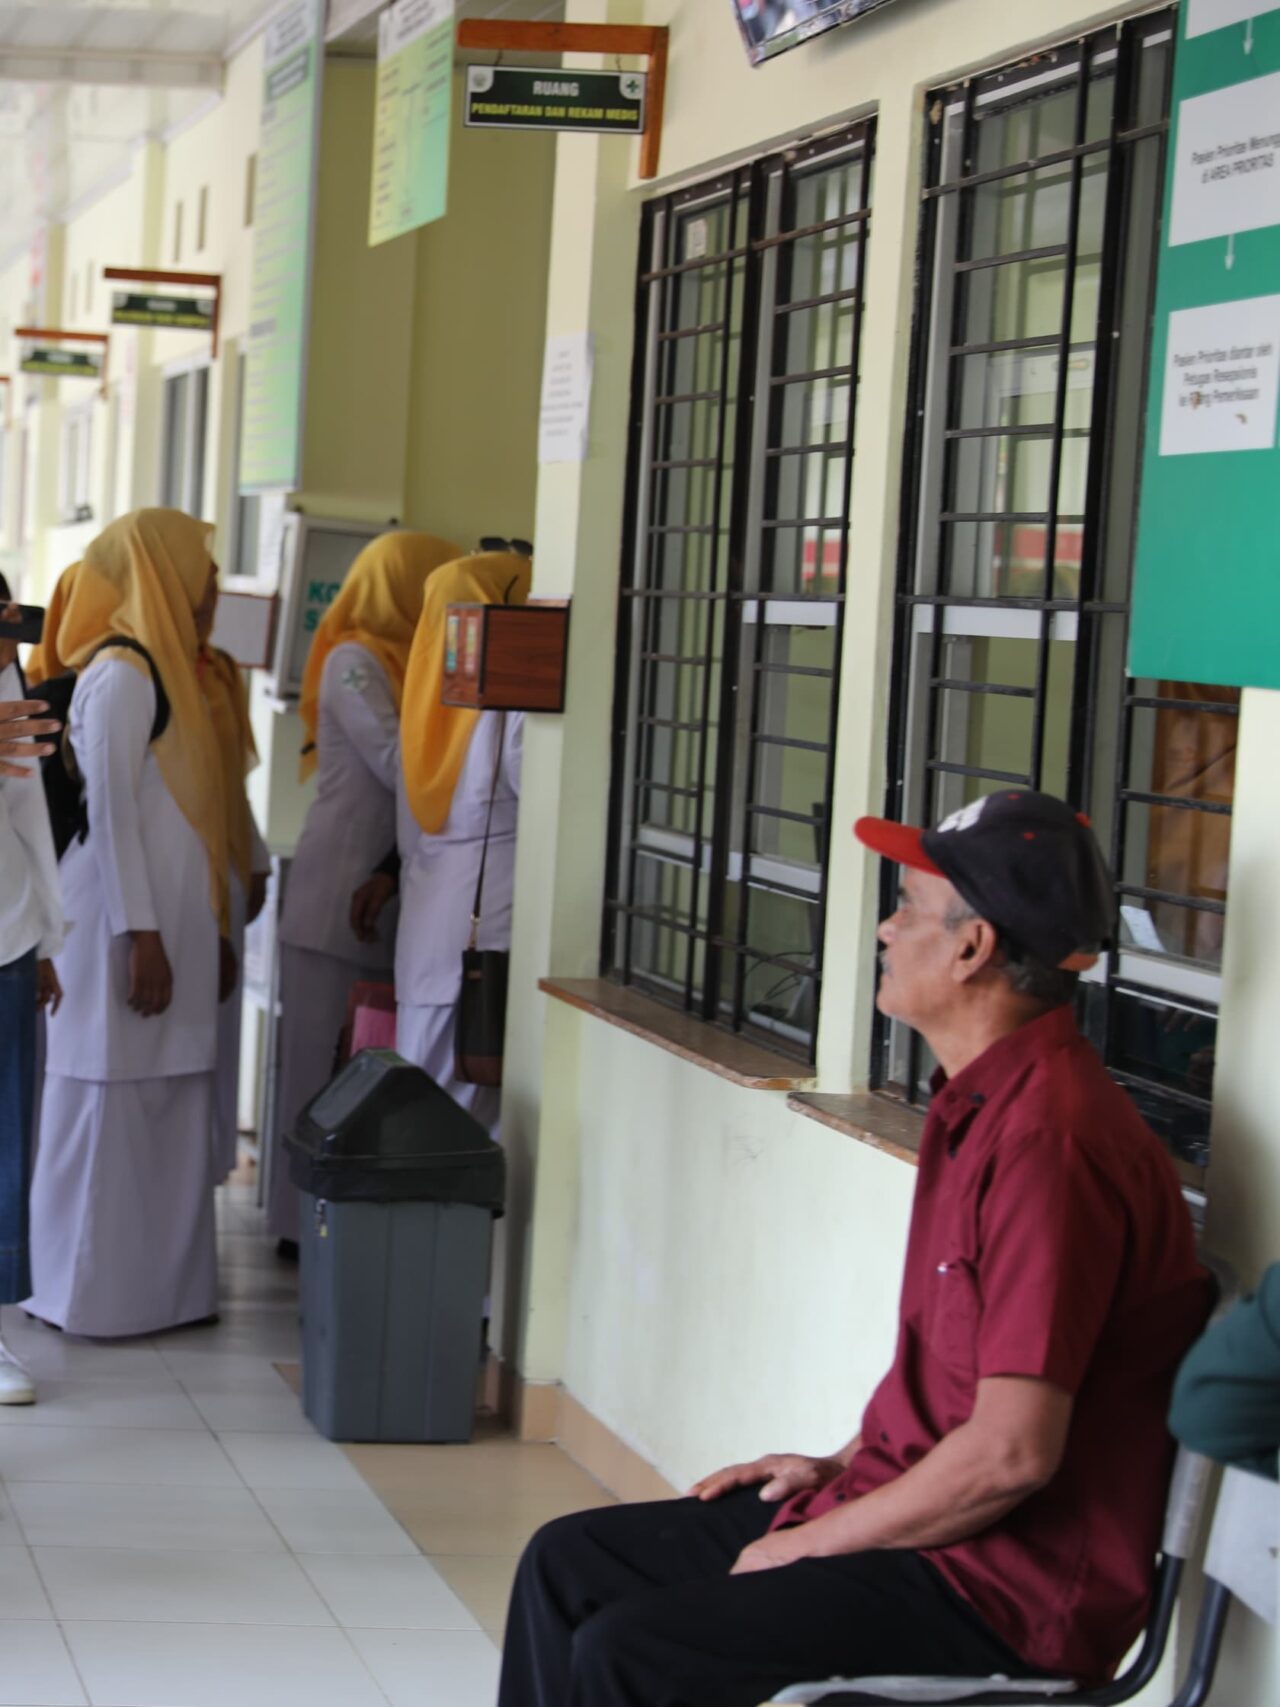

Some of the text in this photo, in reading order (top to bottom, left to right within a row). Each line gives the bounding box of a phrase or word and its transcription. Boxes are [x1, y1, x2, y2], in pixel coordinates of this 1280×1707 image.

[532, 80, 579, 97] RUANG
[471, 102, 638, 121] PENDAFTARAN DAN REKAM MEDIS
